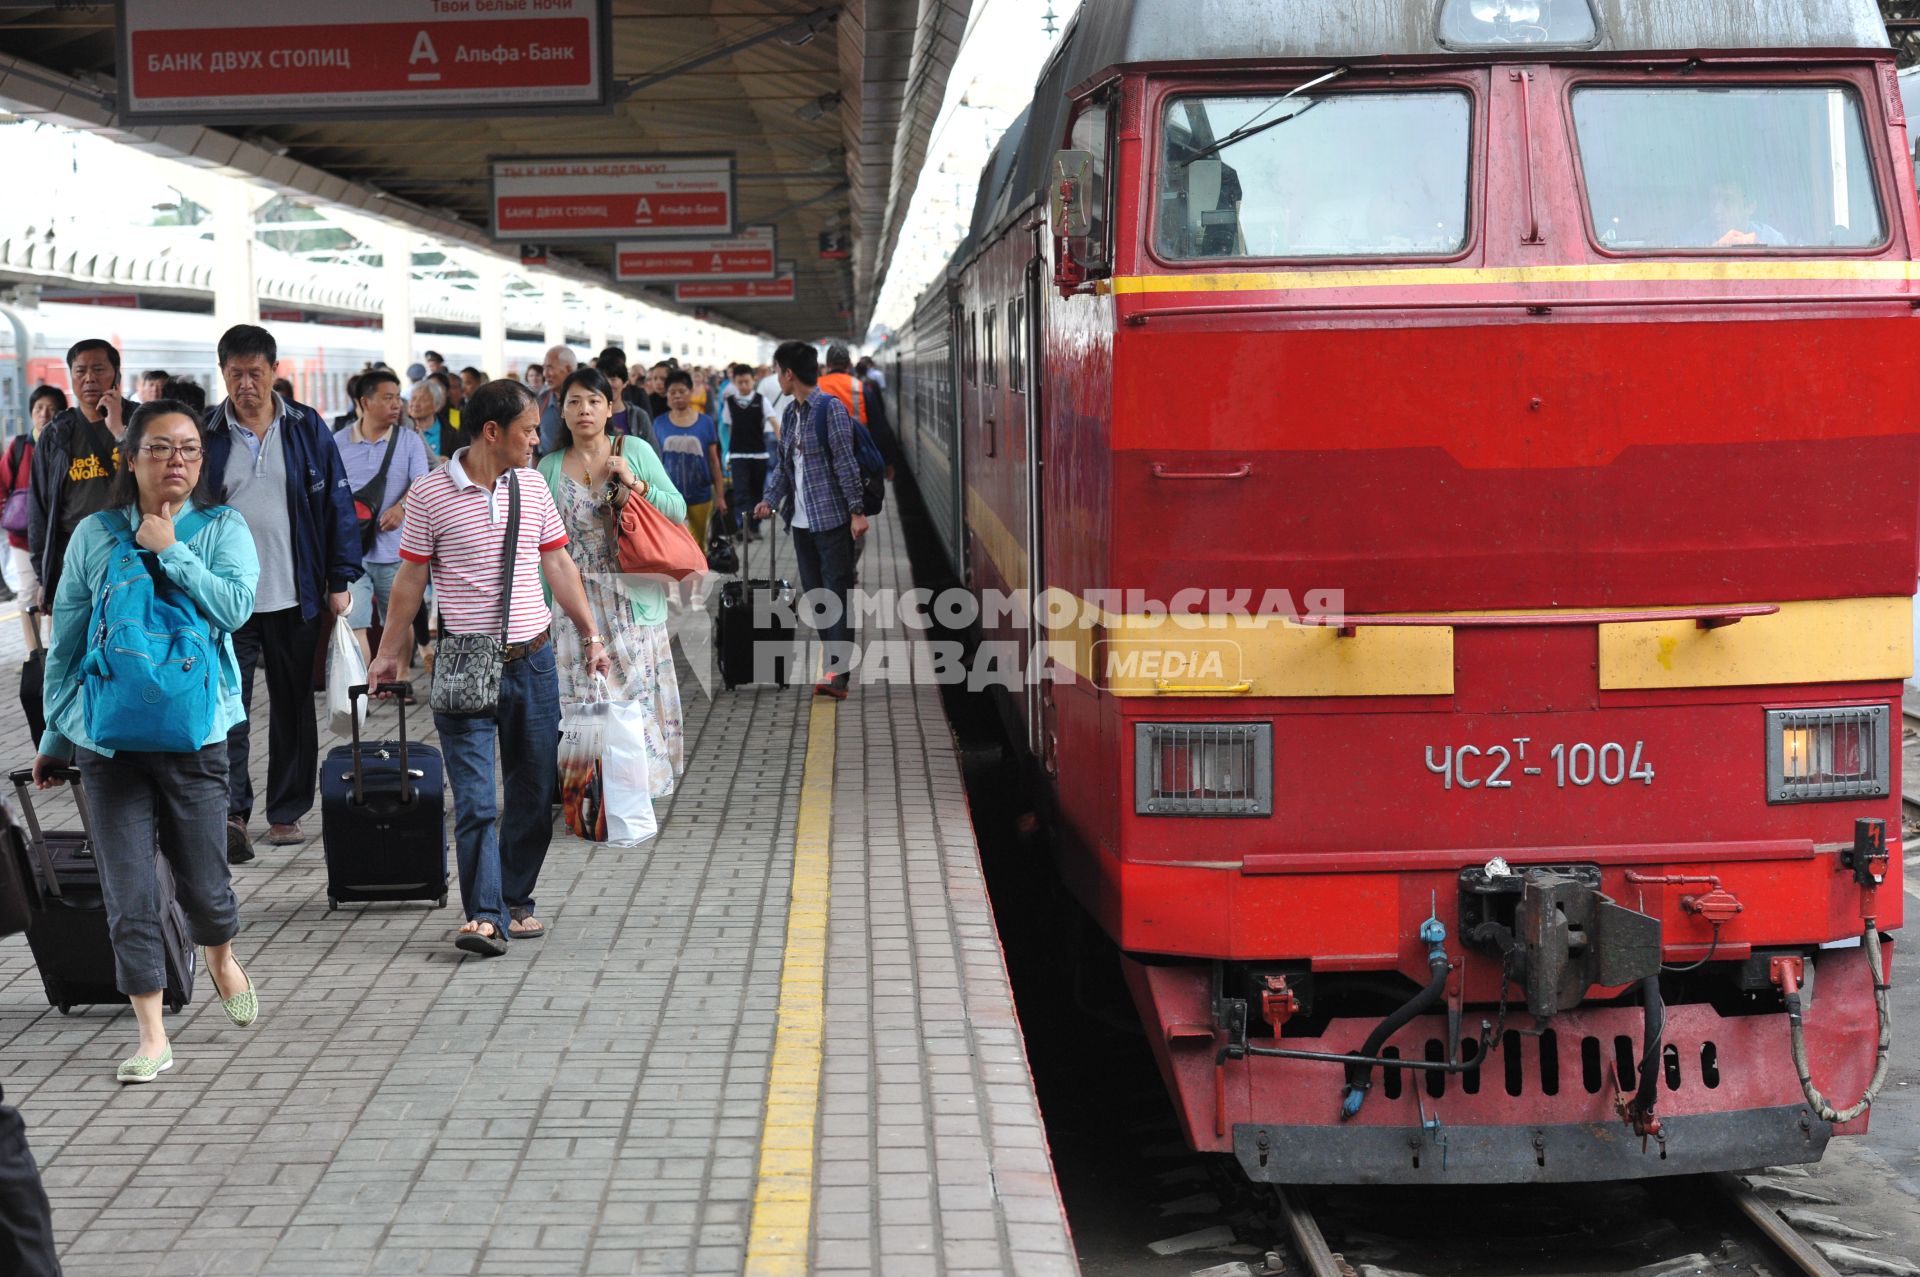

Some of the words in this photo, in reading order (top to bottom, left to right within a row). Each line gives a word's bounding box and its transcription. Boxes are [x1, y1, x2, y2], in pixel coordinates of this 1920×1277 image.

[533, 0, 572, 10] ночи
[148, 53, 203, 72] БАНК
[209, 51, 263, 73] ДВУХ
[269, 49, 351, 69] СТОЛИЦ
[503, 167, 523, 178] ТЫ
[527, 167, 535, 177] К
[539, 166, 568, 177] НАМ
[571, 165, 589, 176] НА
[505, 208, 533, 219] БАНК
[536, 207, 563, 219] ДВУХ
[565, 205, 608, 218] СТОЛИЦ
